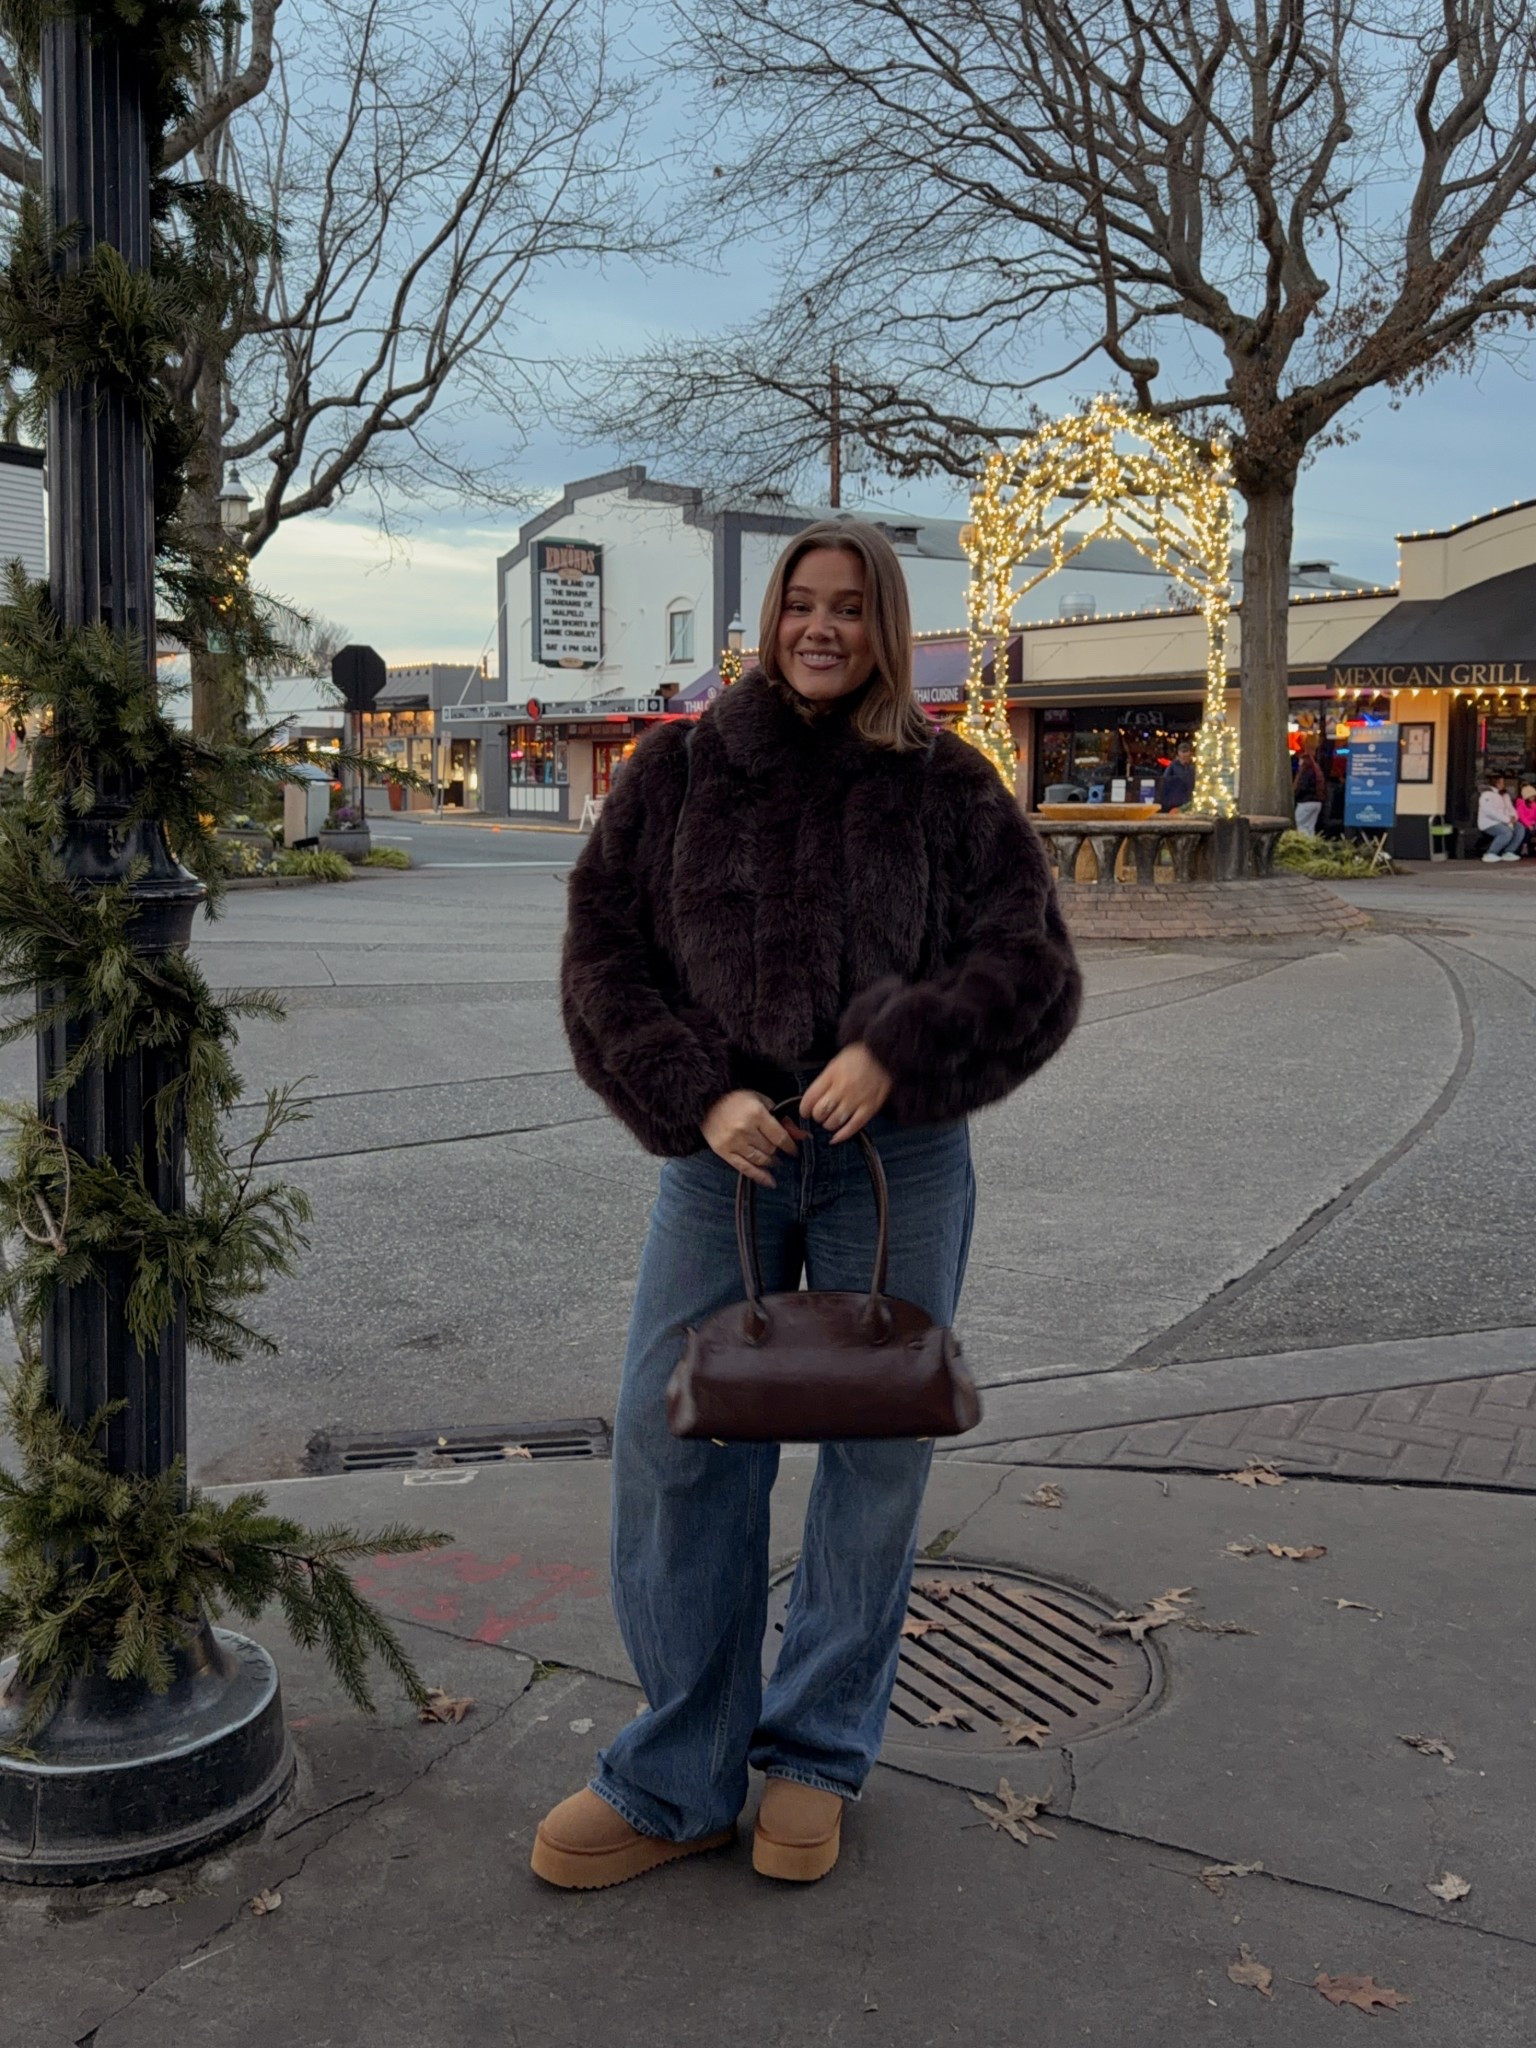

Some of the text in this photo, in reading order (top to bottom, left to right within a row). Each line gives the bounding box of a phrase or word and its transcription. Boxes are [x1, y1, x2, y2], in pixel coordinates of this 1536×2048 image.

[545, 547, 595, 573] EDMONDS
[546, 578, 558, 586] THE
[560, 579, 584, 587] ISLAND
[552, 588, 563, 596] THE
[544, 598, 581, 607] GUARDIANS
[552, 609, 584, 617] MALPELO
[543, 618, 560, 626] PLUS
[562, 619, 588, 627] SHORTS
[1334, 663, 1530, 687] MEXICAN GRILL
[913, 687, 959, 702] THAI CUISINE
[684, 701, 704, 713] THAI
